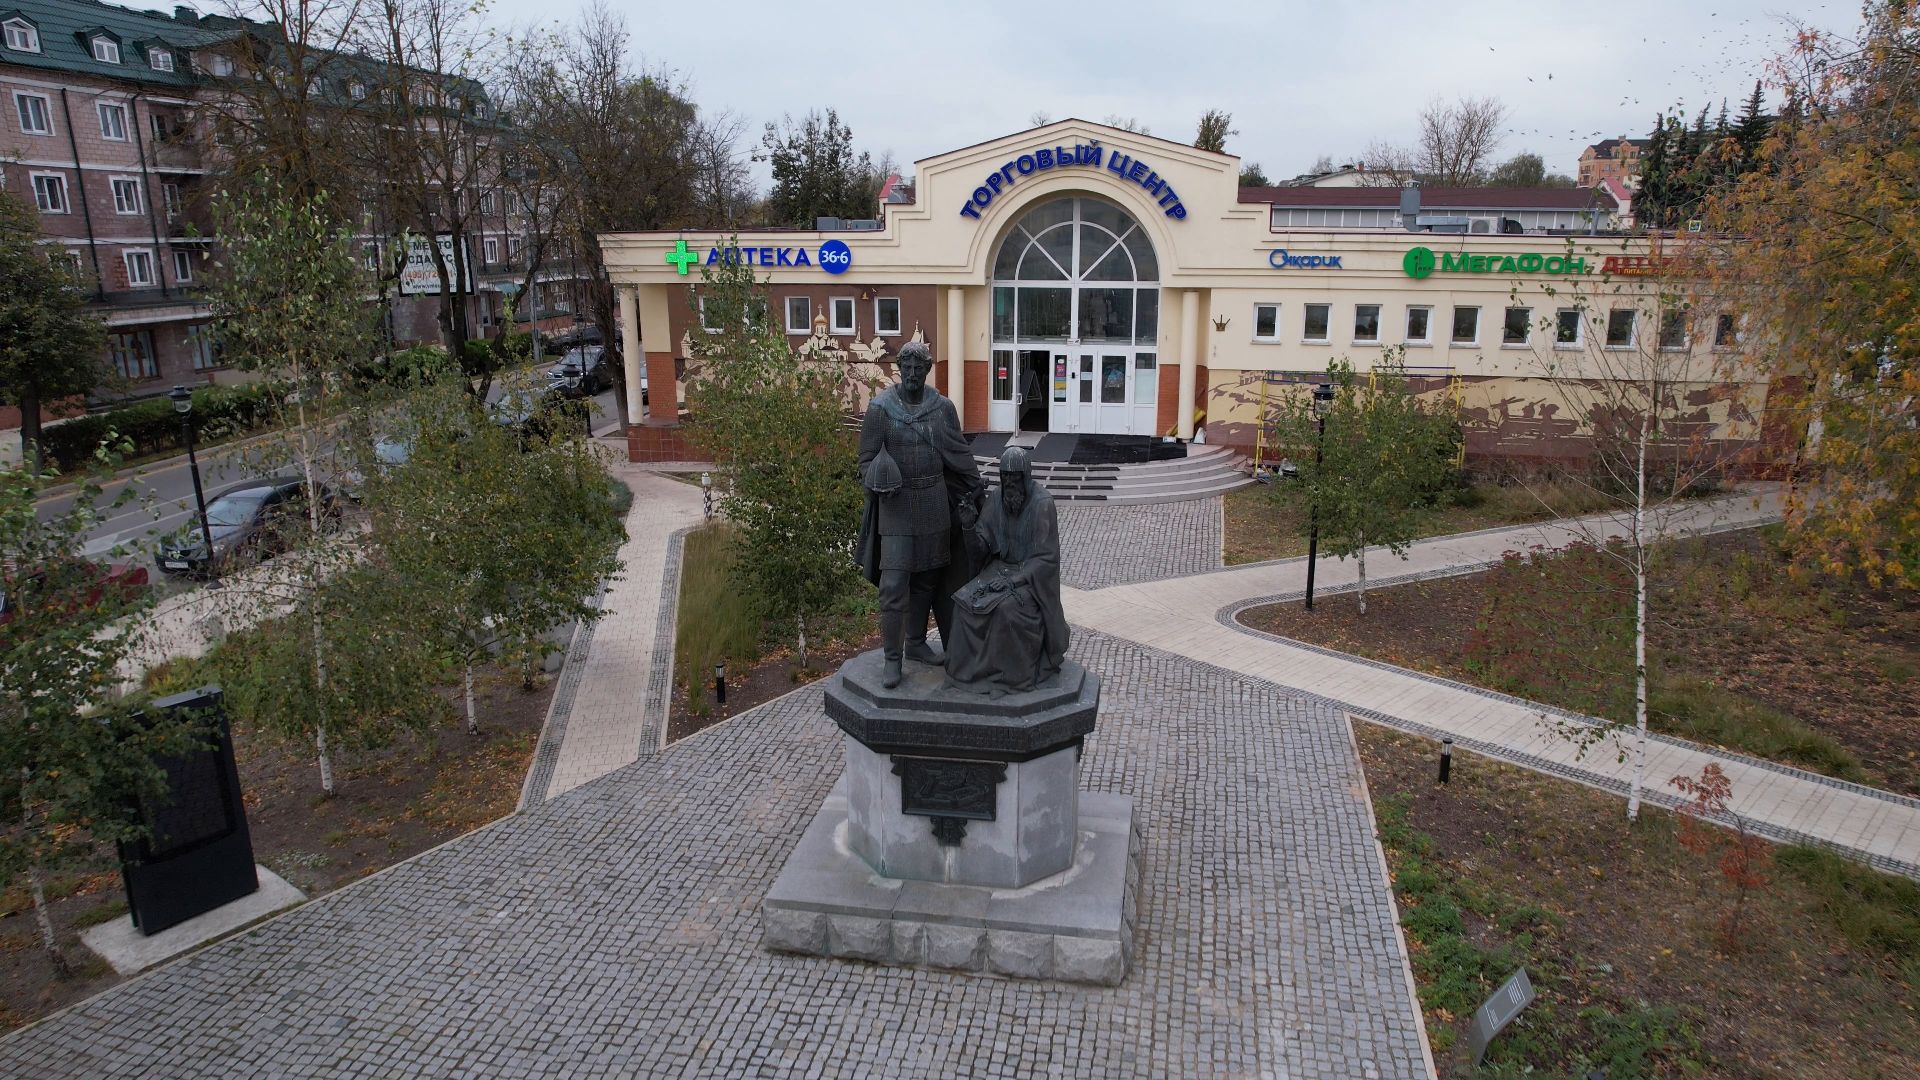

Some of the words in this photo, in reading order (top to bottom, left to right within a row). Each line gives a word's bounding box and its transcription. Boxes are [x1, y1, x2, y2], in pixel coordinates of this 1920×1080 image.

[960, 139, 1103, 219] ТОРГОВЫЙ
[1107, 150, 1187, 220] ЦЕНТР
[413, 241, 452, 250] МЕТО
[705, 248, 811, 266] АПТЕКА
